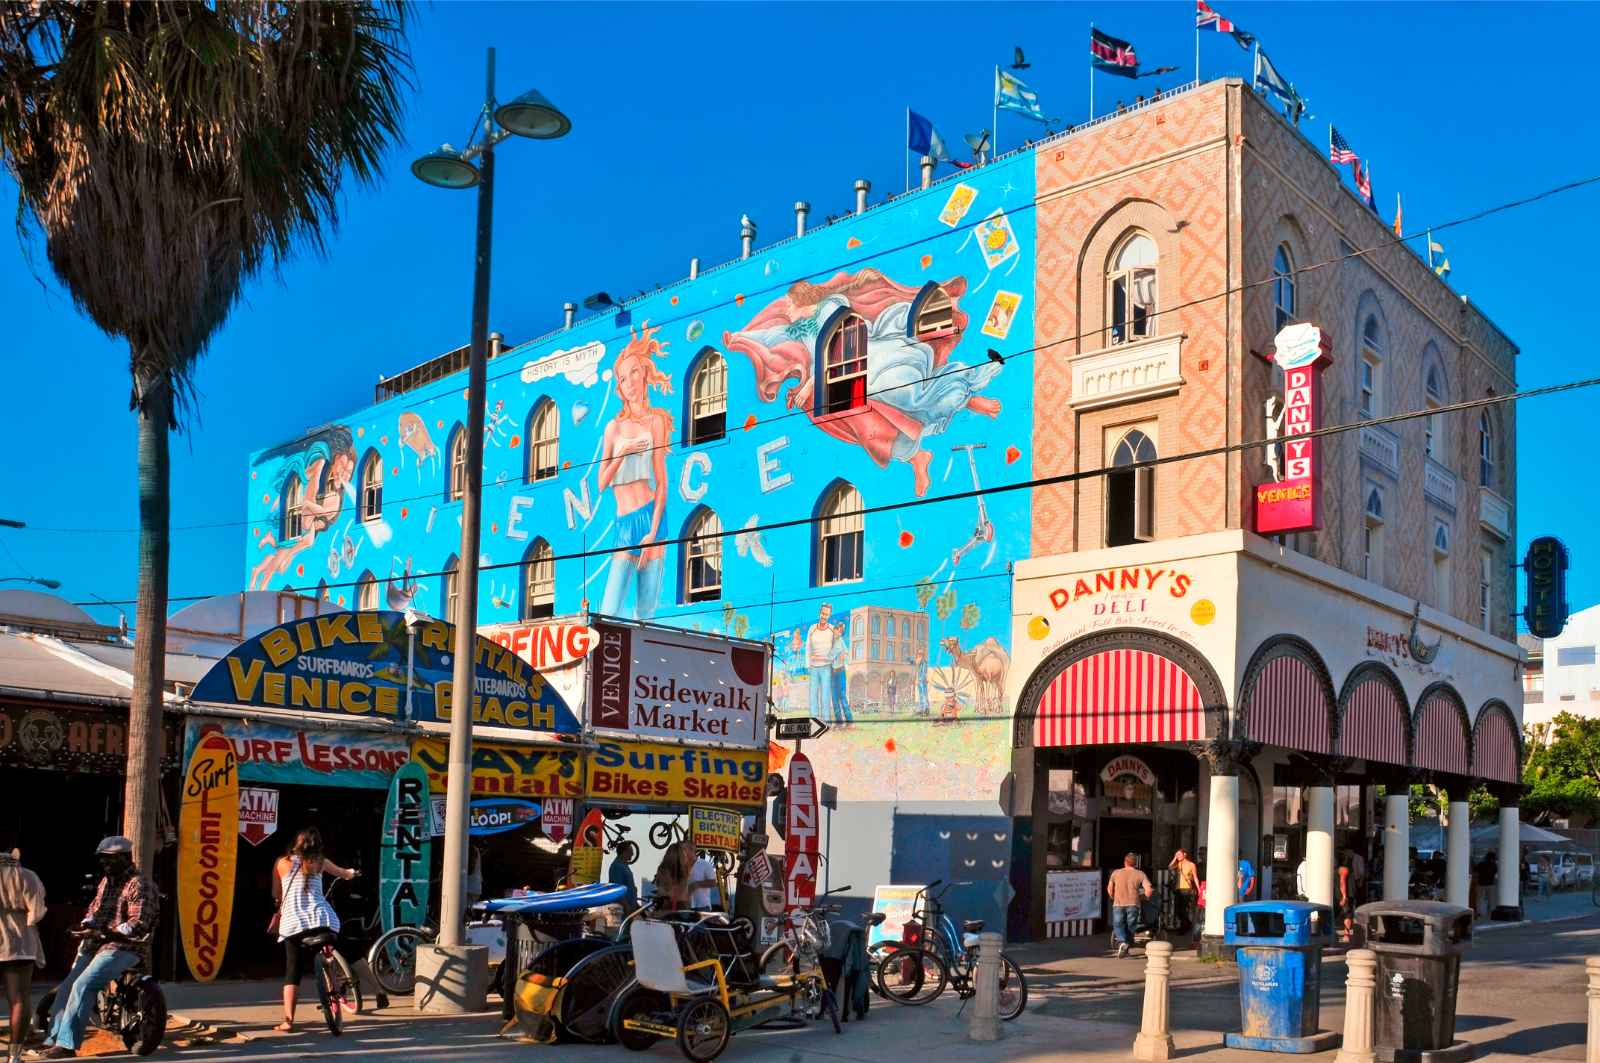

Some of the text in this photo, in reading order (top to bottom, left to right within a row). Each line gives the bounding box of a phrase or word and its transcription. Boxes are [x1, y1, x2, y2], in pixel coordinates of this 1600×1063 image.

[527, 347, 599, 377] HISTORY IS MYTH
[1291, 371, 1307, 476] DANNYS
[1048, 567, 1192, 611] DANNY'S
[1094, 598, 1147, 616] DELI
[260, 614, 383, 667] BIKE
[297, 656, 375, 678] SURFBOARDS
[602, 632, 622, 719] VENICE
[227, 657, 399, 715] VENICE
[634, 675, 752, 712] Sidewalk
[634, 703, 730, 736] Market
[297, 731, 409, 773] LESSONS
[595, 743, 764, 783] Surfing
[188, 752, 235, 797] Surf
[1108, 758, 1149, 780] DANNY'S
[239, 790, 277, 811] ATM
[592, 770, 763, 801] Bikes Skates
[239, 811, 276, 821] MACHINE
[471, 812, 512, 827] LOOP!
[543, 801, 572, 815] ATM
[544, 815, 571, 825] MACHINE
[699, 821, 737, 836] BICYCLE
[194, 789, 221, 977] LESSONS
